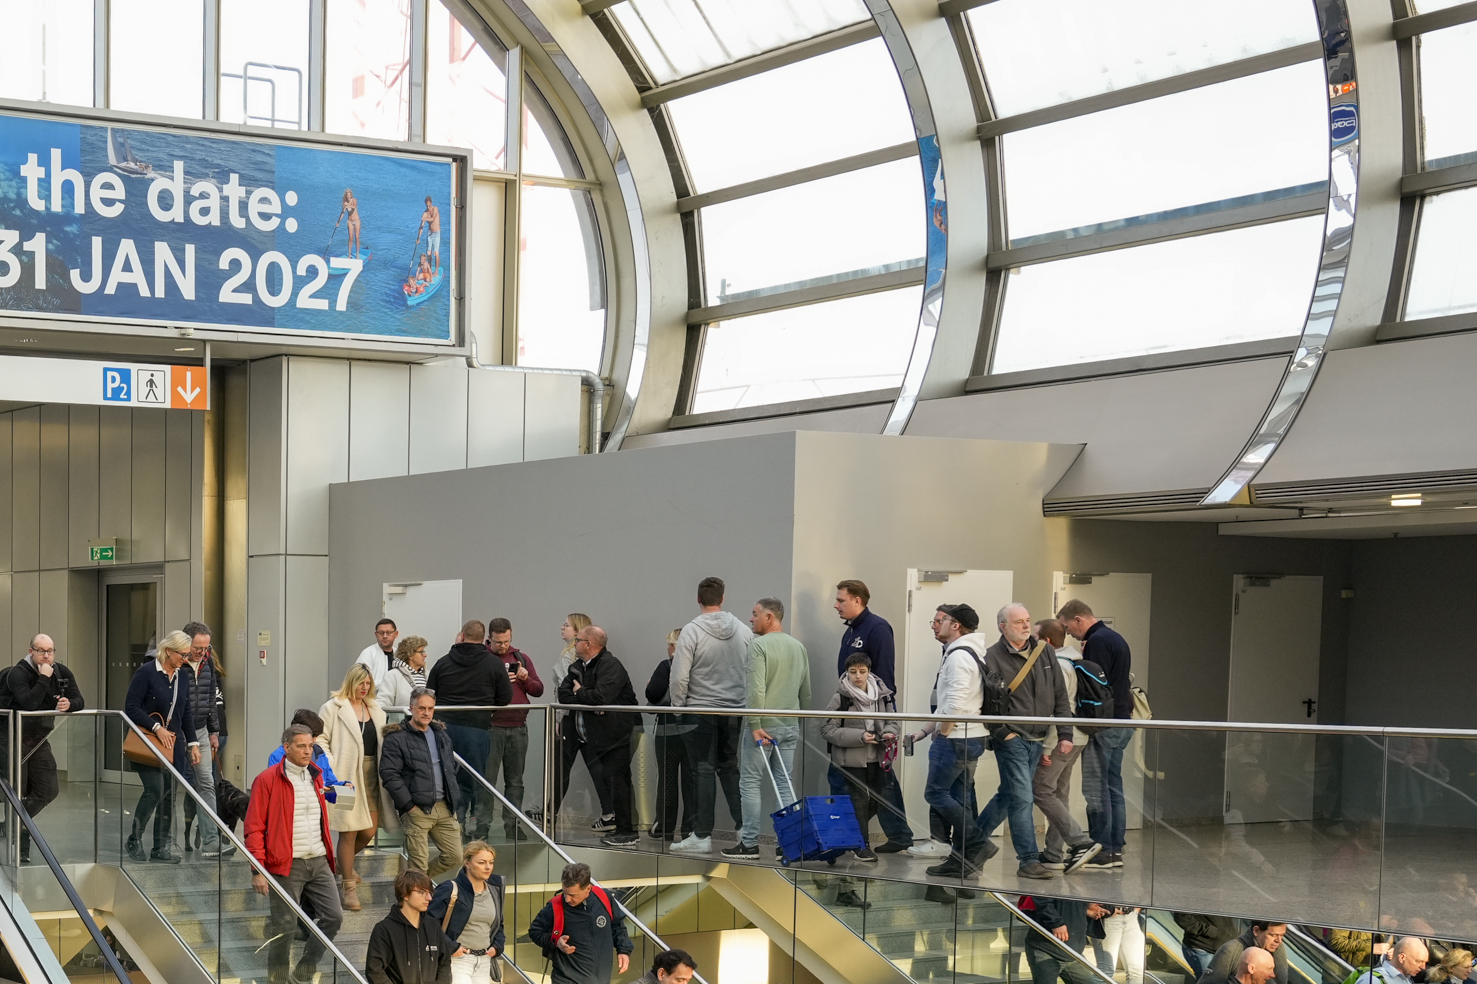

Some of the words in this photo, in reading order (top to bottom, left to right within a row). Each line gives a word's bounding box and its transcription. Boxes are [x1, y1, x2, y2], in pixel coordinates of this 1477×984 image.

[21, 148, 126, 218] the
[146, 160, 299, 234] date:
[70, 236, 197, 301] JAN
[218, 247, 364, 312] 2027
[107, 371, 128, 399] P2
